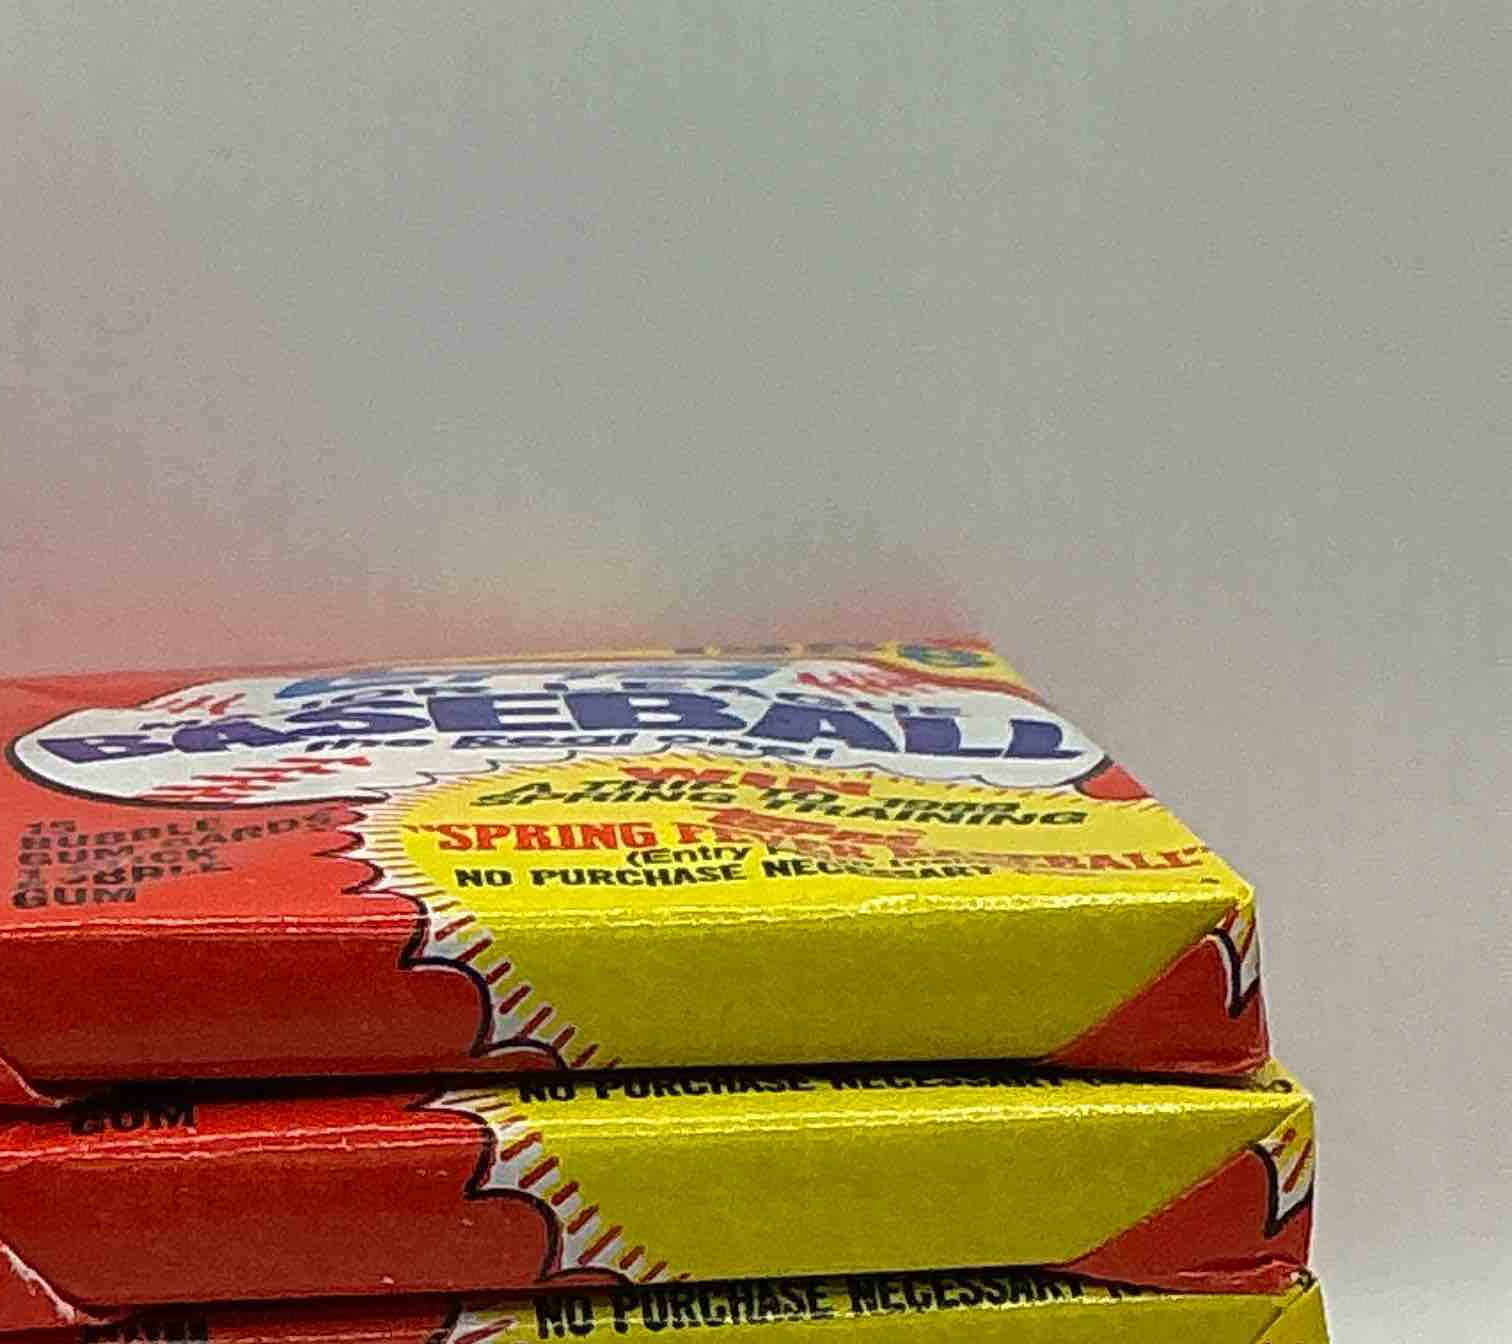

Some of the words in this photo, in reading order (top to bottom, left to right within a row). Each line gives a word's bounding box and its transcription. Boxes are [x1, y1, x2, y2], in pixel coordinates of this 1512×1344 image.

[37, 690, 1086, 764] BASEBALL
[455, 867, 514, 888] NO
[529, 863, 749, 888] PURCHASE
[11, 886, 137, 910] GUM
[534, 1293, 595, 1339] NO
[609, 1281, 834, 1334] PURCHASE
